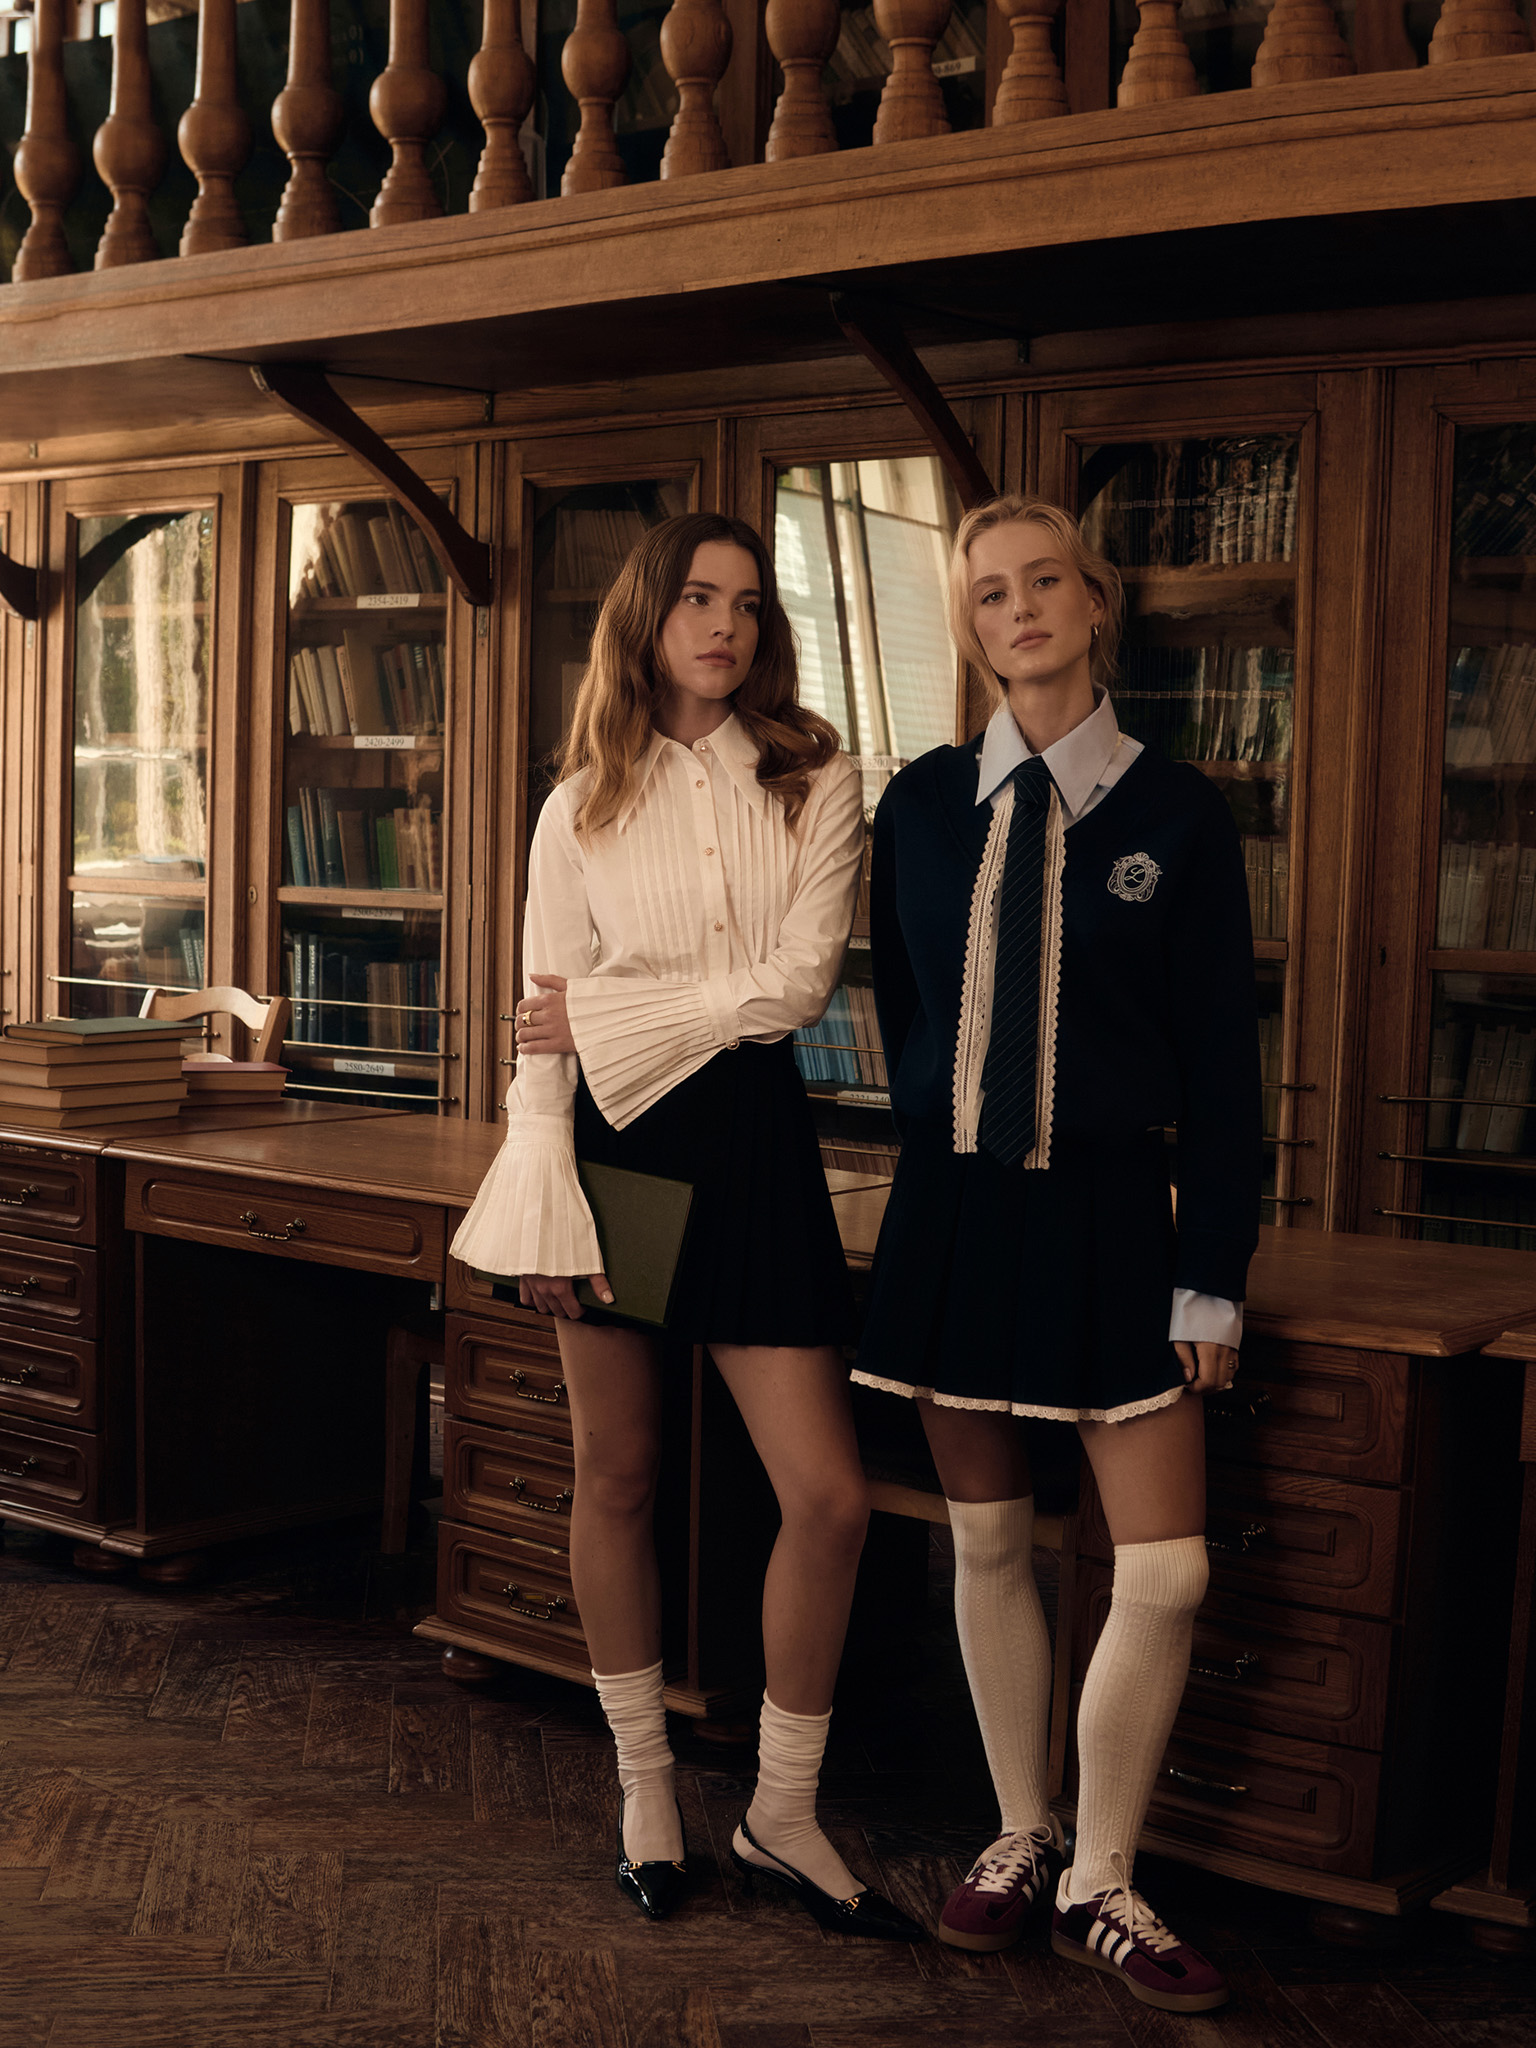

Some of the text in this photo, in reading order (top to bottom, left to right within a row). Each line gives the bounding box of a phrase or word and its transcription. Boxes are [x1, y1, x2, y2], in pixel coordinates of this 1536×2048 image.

[367, 595, 409, 607] 2354-2419
[364, 737, 405, 747] 2420-2499
[344, 1062, 384, 1074] 2580-2649
